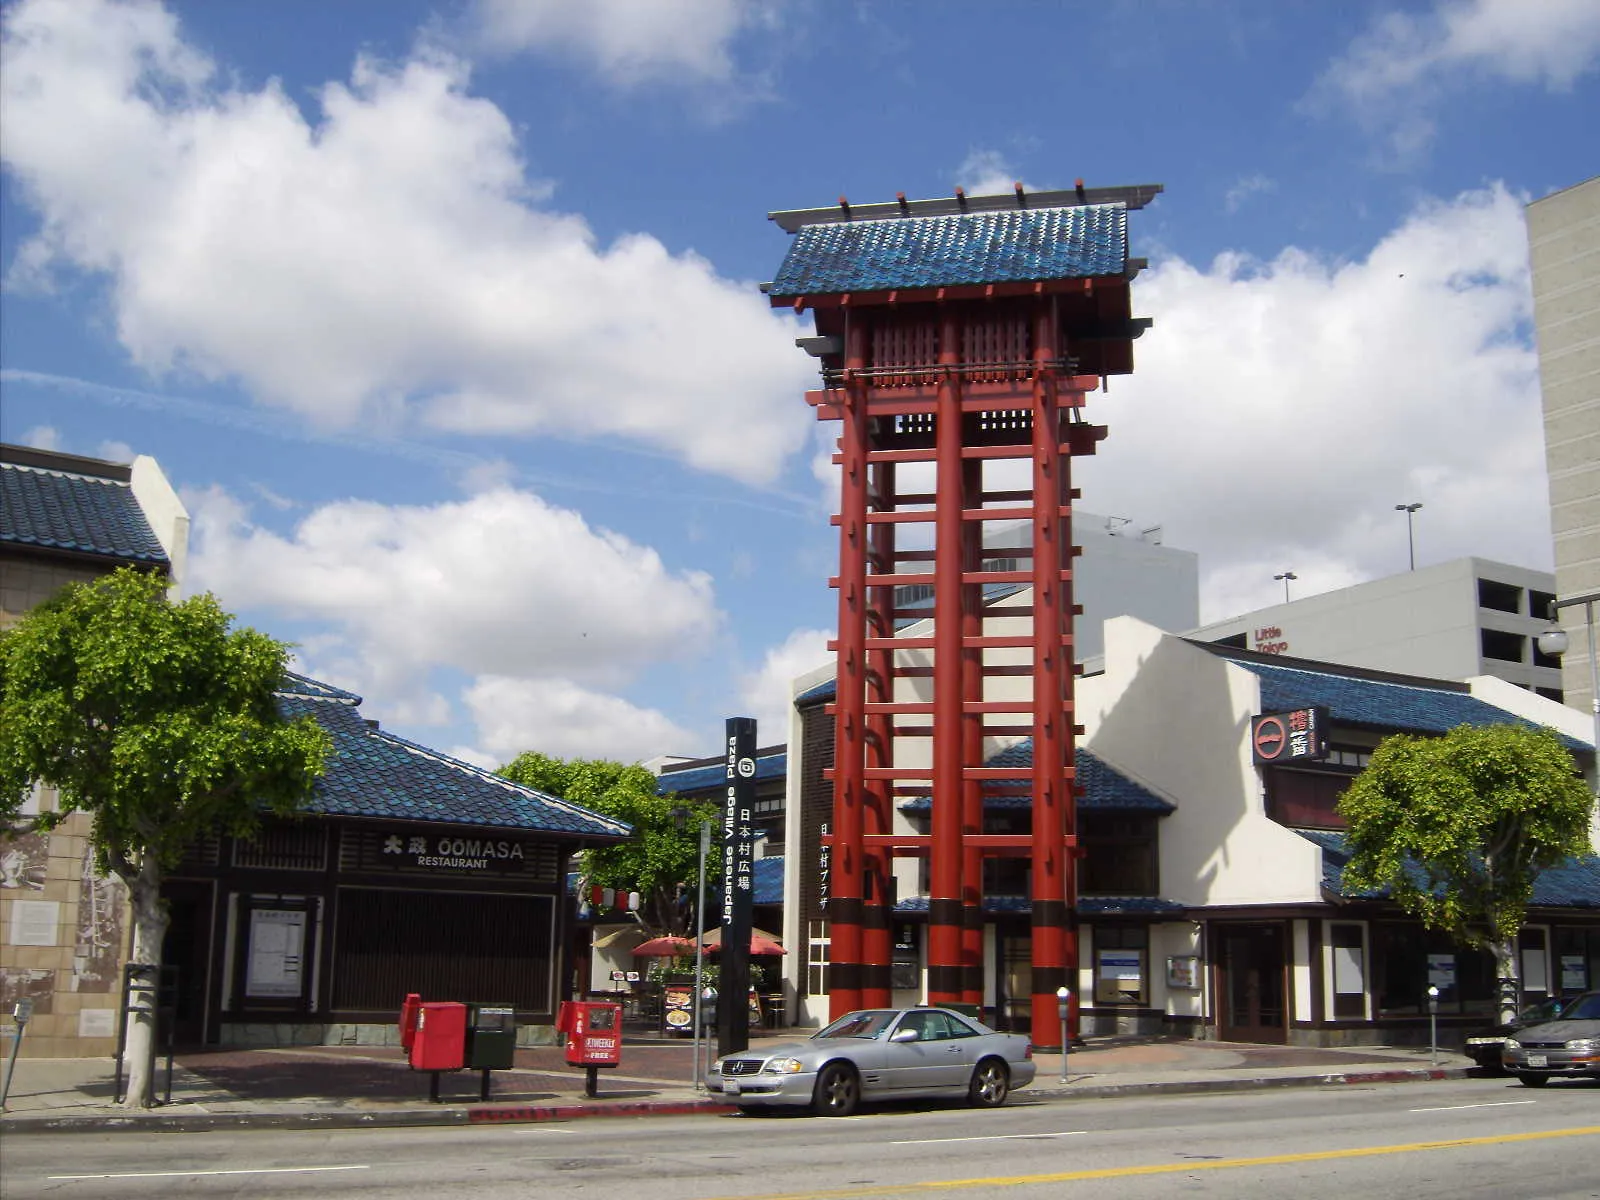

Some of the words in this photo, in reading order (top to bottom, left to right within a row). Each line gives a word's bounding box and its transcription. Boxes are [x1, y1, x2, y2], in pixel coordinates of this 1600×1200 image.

[1255, 626, 1282, 641] Little
[1255, 642, 1288, 654] Tokyo
[727, 736, 737, 779] Plaza
[725, 786, 736, 839] Village
[417, 856, 488, 869] RESTAURANT
[738, 808, 751, 890] 日本村広場
[723, 846, 734, 925] Japanese
